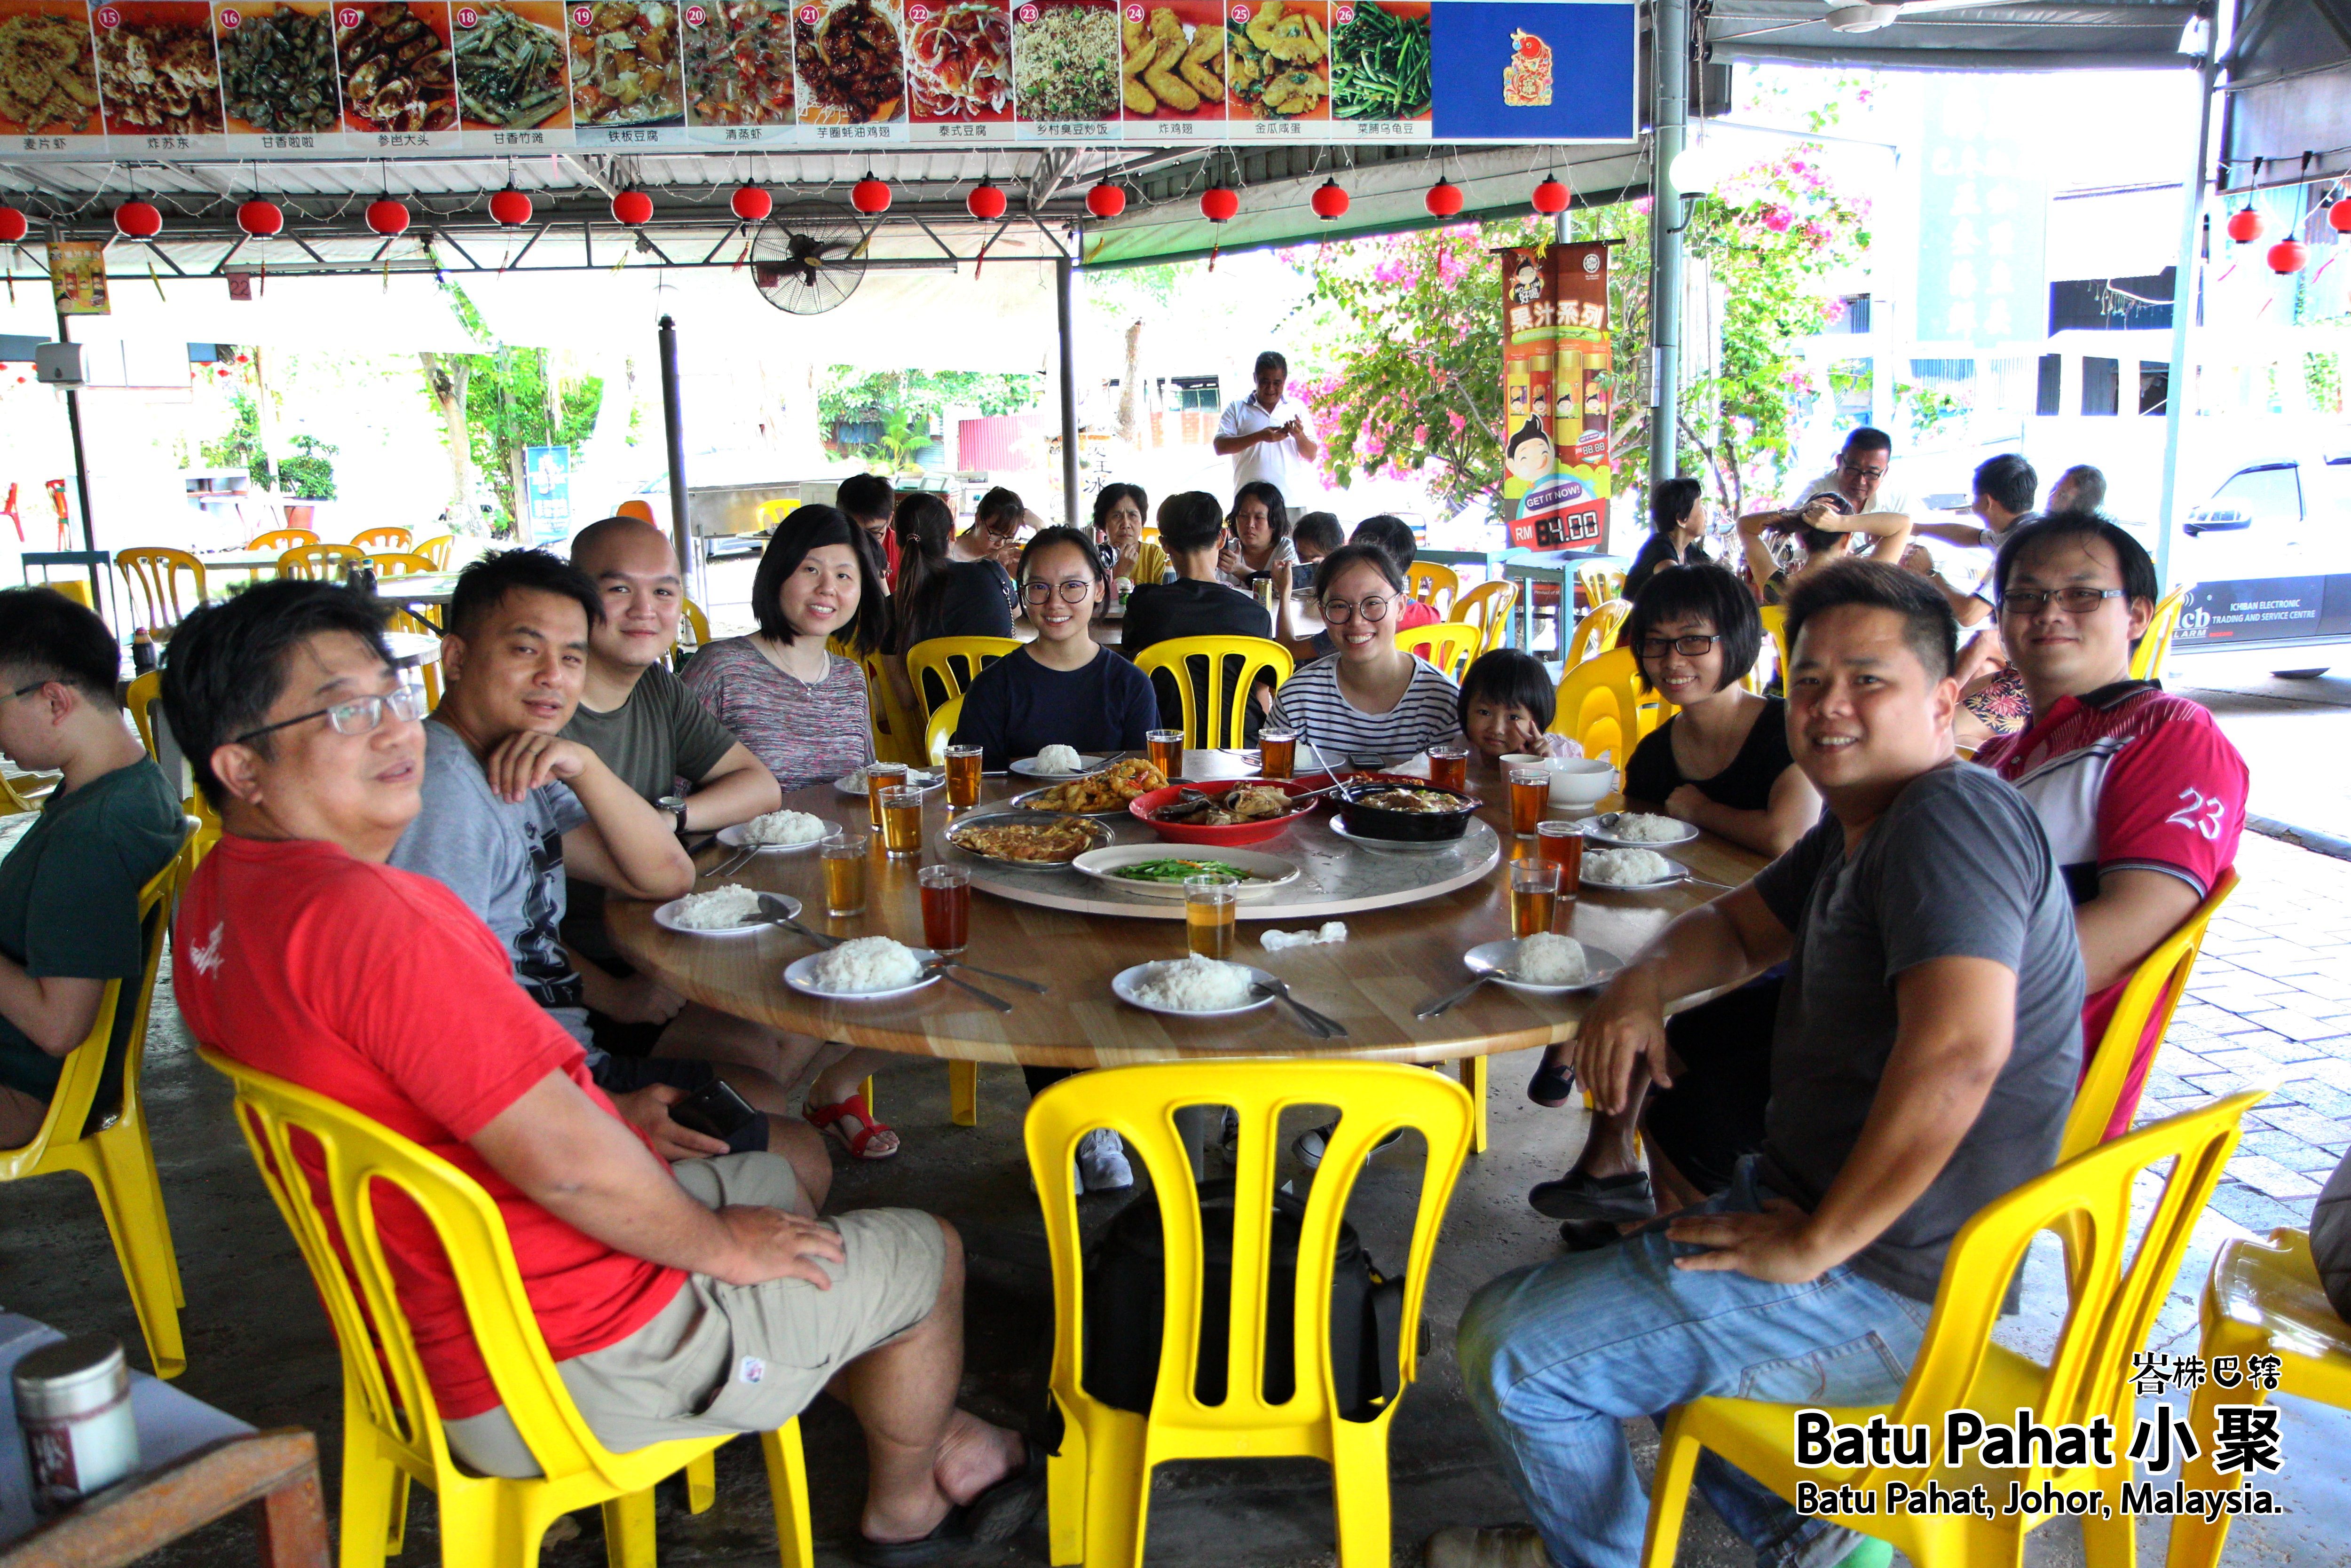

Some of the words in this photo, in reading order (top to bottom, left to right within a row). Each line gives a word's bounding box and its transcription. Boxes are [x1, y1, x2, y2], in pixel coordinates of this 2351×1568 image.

[101, 13, 116, 23] 15
[223, 13, 237, 23] 16
[342, 13, 356, 23] 17
[460, 12, 474, 23] 18
[576, 12, 589, 22] 19
[689, 10, 703, 21] 20
[803, 9, 815, 20] 21
[912, 9, 926, 19] 22
[1023, 8, 1036, 19] 23
[1128, 8, 1142, 19] 24
[1234, 8, 1247, 19] 25
[1339, 10, 1352, 21] 26
[817, 126, 890, 139] 芋圈蚝油鸡翅
[939, 125, 986, 136] 泰式豆腐
[1037, 124, 1108, 135] 乡村臭豆炒饭
[1159, 123, 1193, 134] 炸鸡翅
[1255, 123, 1301, 134] 金瓜咸蛋
[1357, 123, 1413, 134] 菜脯乌龟豆
[608, 130, 658, 142] 铁板豆腐
[726, 129, 762, 140] 清蒸虾
[24, 138, 66, 150] 麦片虾
[148, 137, 189, 149] 炸苏东
[262, 136, 314, 148] 甘香啦啦
[1519, 287, 1539, 305] 好喝
[1510, 301, 1603, 332] 果汁系列
[1526, 496, 1544, 507] GET
[1545, 493, 1553, 502] IT
[1554, 485, 1580, 500] NOW!
[1515, 526, 1533, 541] RM
[2230, 601, 2258, 611] ICHIBAN
[2259, 599, 2301, 610] ELECTRONIC
[2212, 615, 2243, 624] TRADING
[2244, 614, 2260, 622] AND
[2261, 612, 2288, 621] SERVICE
[2289, 610, 2316, 619] CENTRE
[2173, 629, 2207, 638] LARM
[2165, 787, 2225, 840] 23
